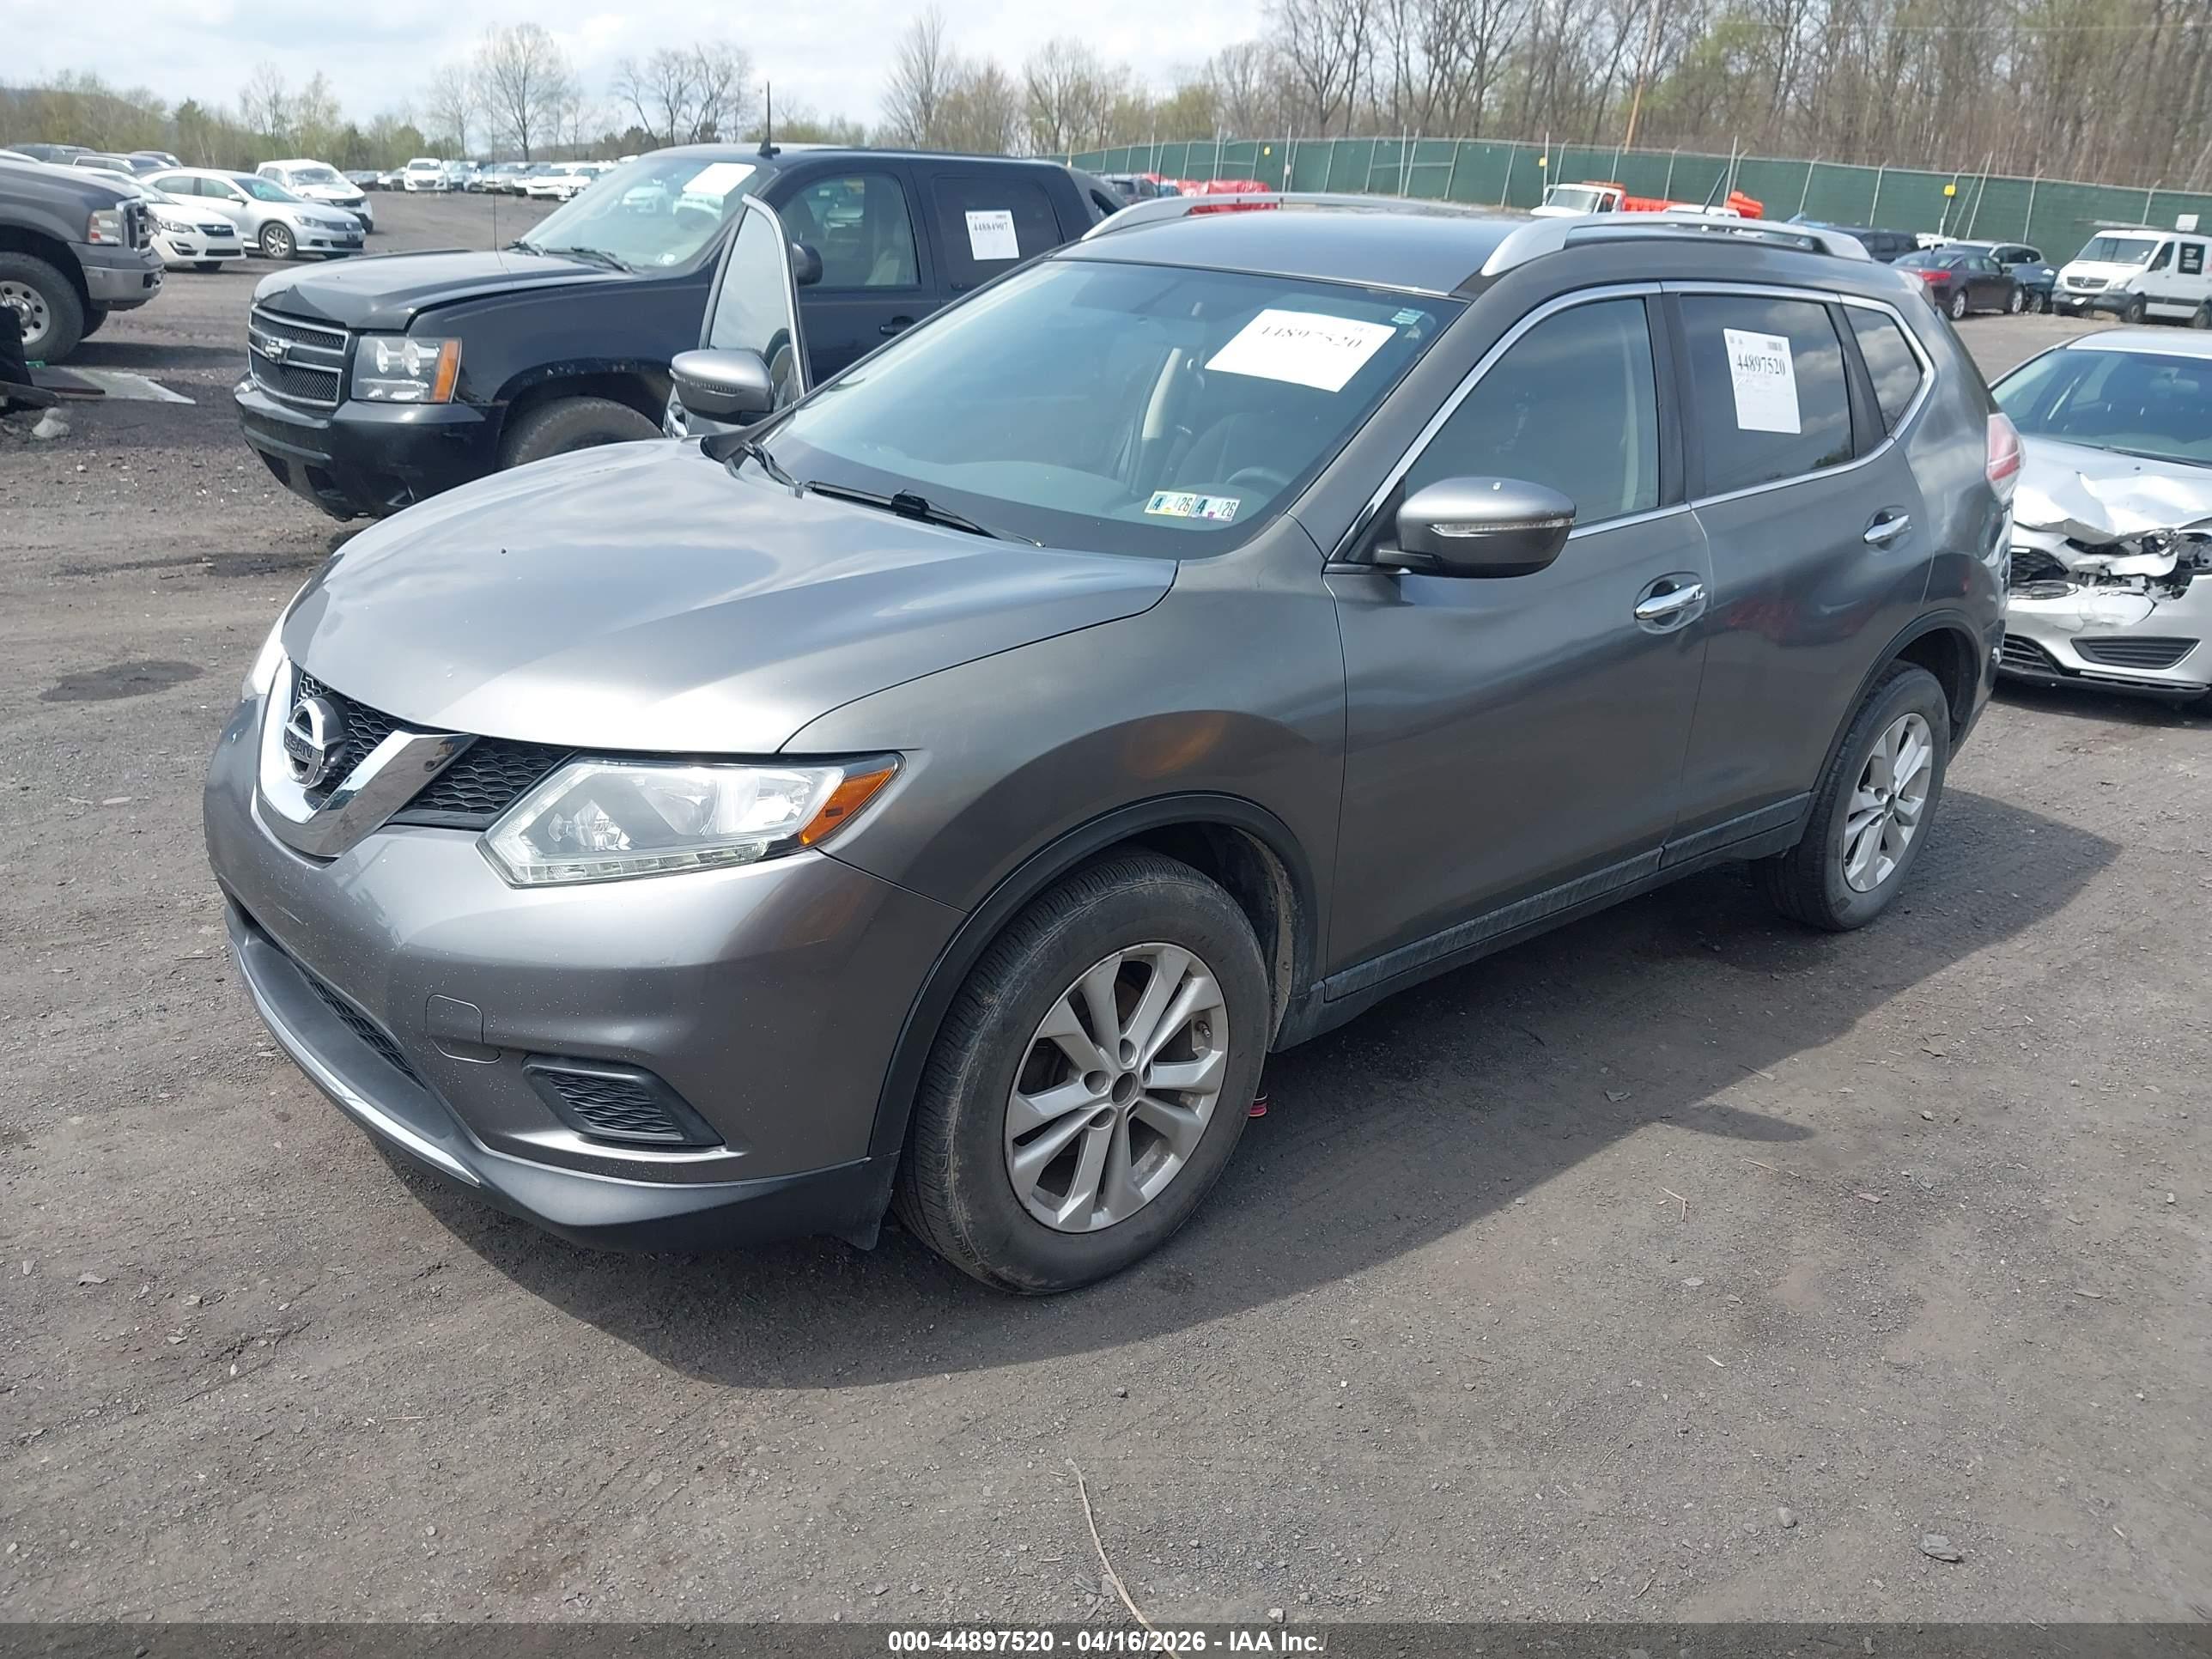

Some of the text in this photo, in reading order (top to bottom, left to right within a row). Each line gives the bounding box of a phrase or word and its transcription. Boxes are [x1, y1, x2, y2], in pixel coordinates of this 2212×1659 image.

[1736, 352, 1786, 377] 44897520
[1153, 496, 1194, 513] 4 26
[1196, 498, 1237, 517] 4 26
